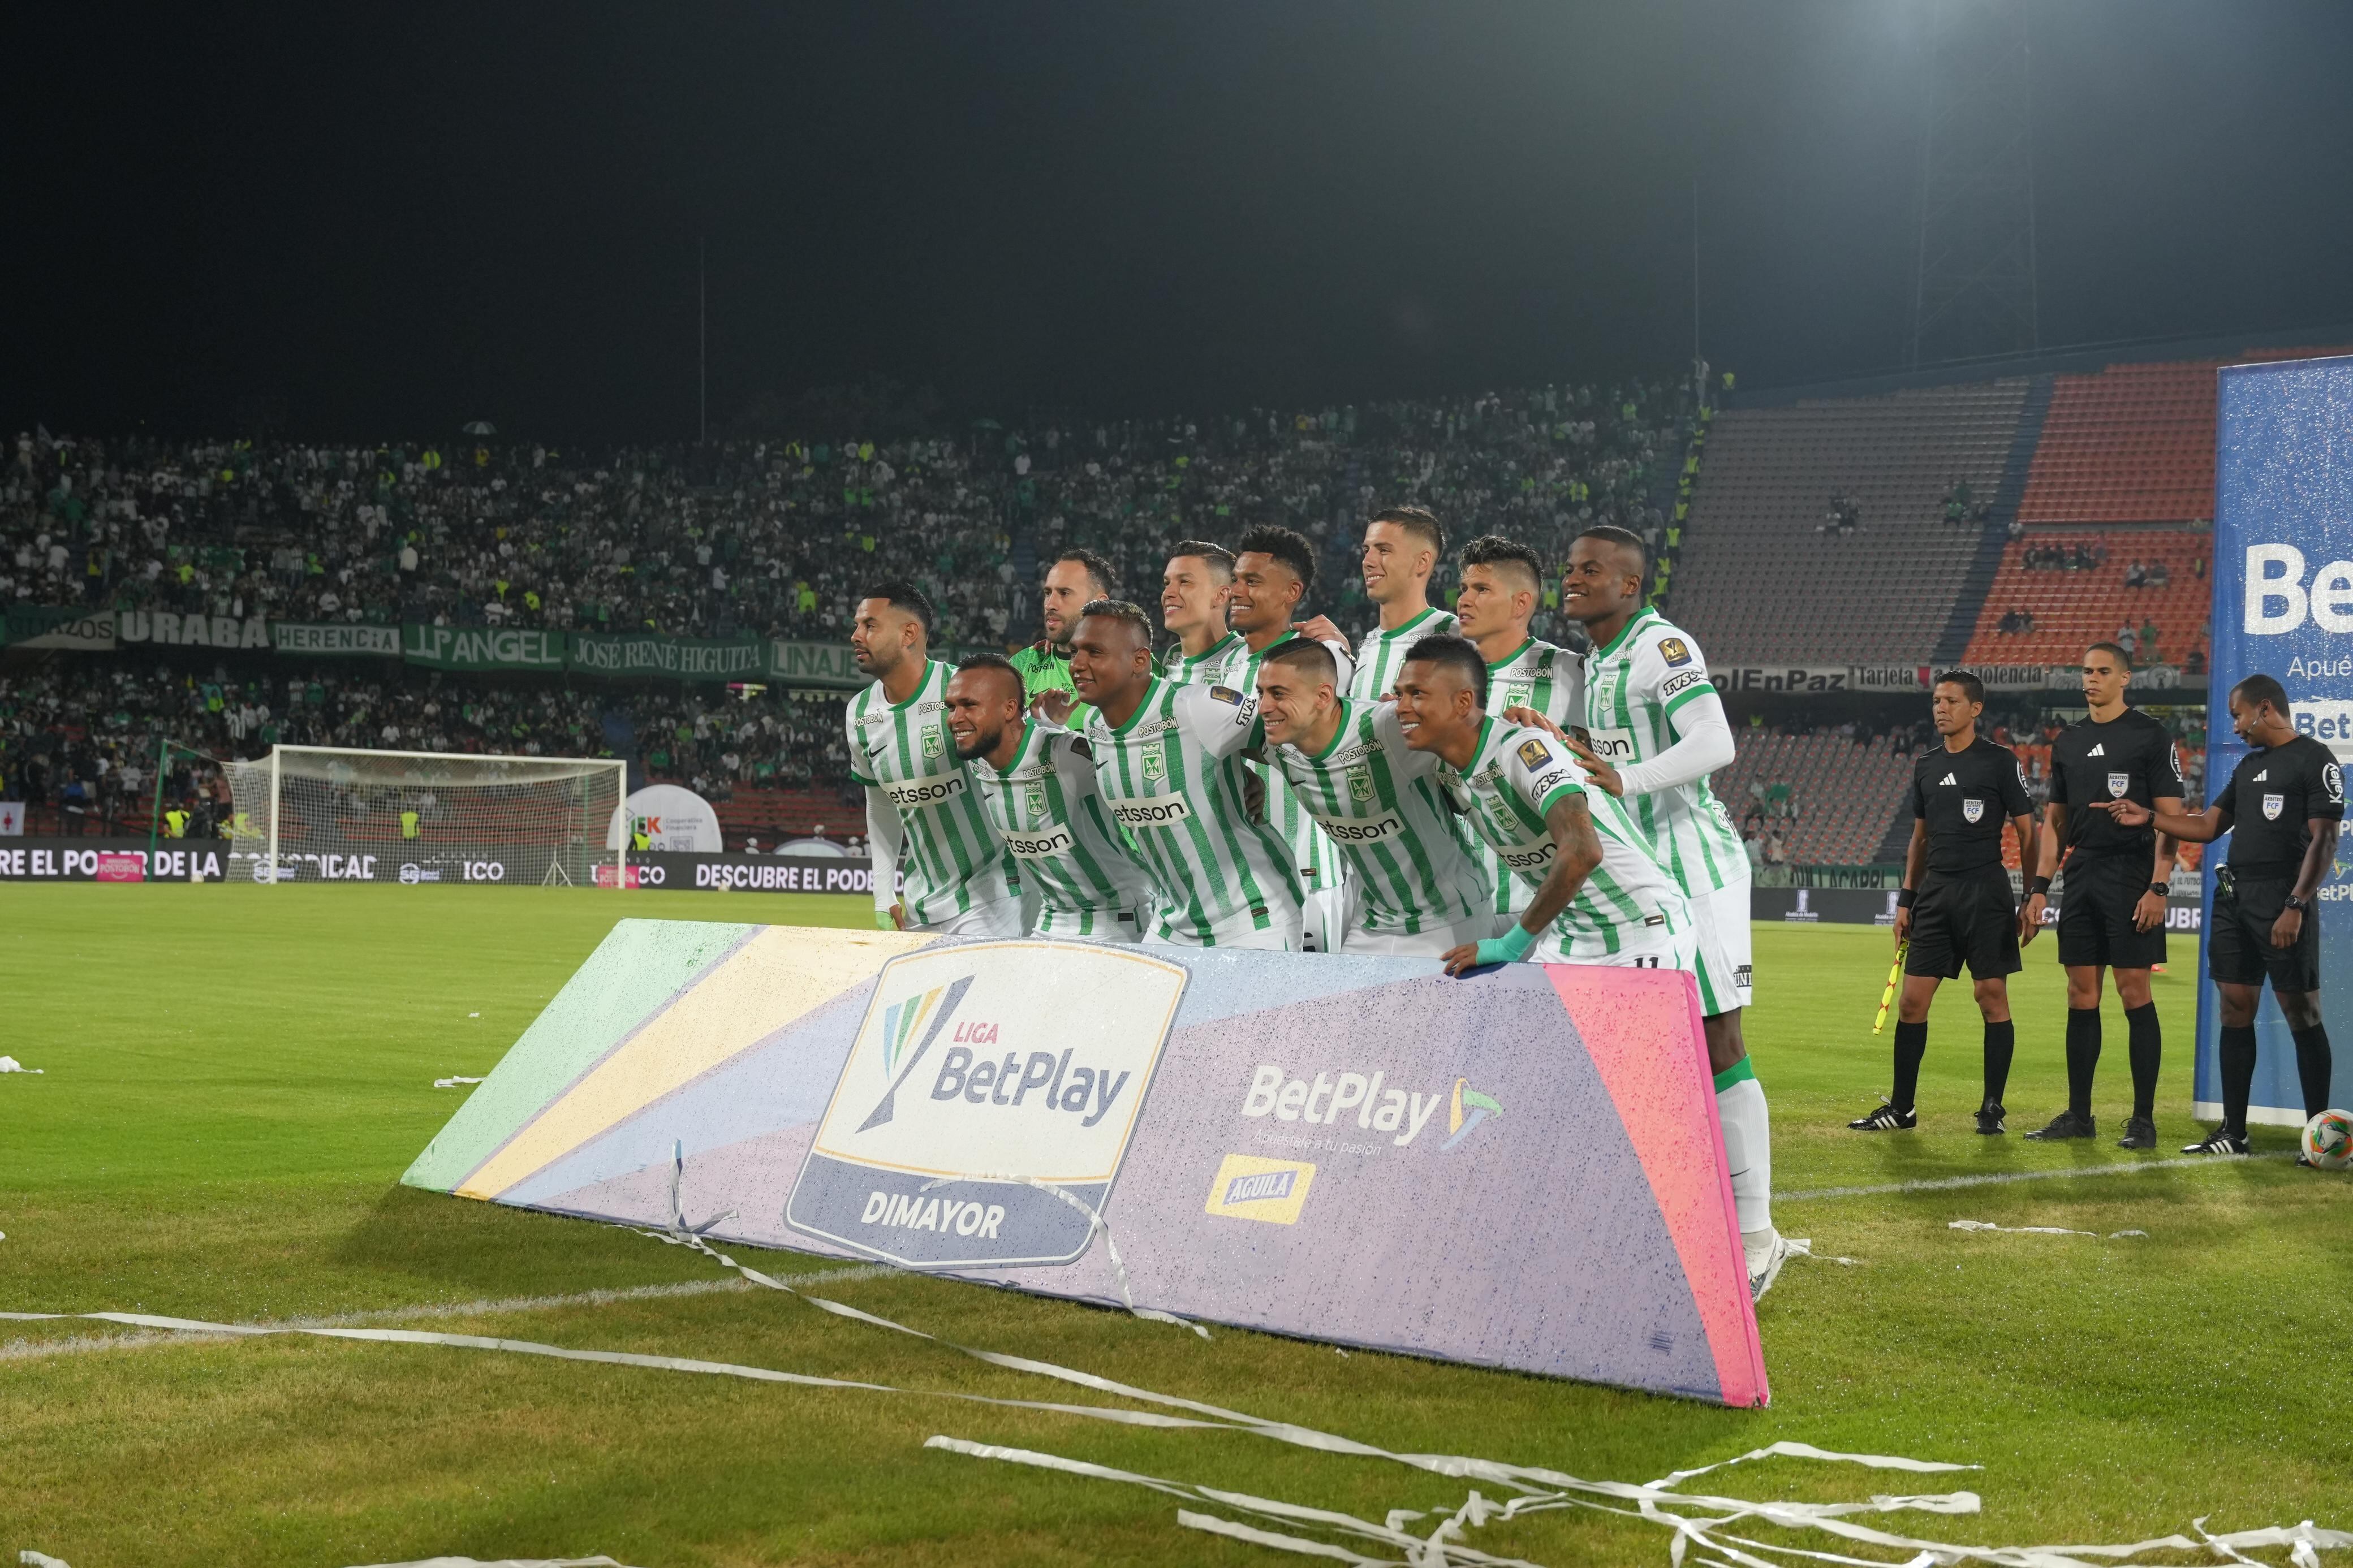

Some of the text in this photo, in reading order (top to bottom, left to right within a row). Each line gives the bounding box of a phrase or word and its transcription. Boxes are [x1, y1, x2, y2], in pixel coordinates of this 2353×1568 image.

[122, 611, 270, 649] URABA
[453, 629, 561, 663] ANGEL
[575, 636, 761, 673] JOSÉ RENÉ HIGUITA
[772, 643, 860, 680] LINAJE
[1510, 663, 1554, 680] POSTOBÓN
[1663, 671, 1692, 697] TVS
[1859, 666, 1913, 687] Tarjeta
[853, 709, 884, 730] POSTOBÓN
[919, 701, 949, 715] POSTOB
[1138, 715, 1179, 738] POSTOBÓN
[2295, 712, 2350, 739] Bet
[1337, 737, 1385, 764] POSTOBÓN
[1023, 759, 1057, 778] POSTOBÓN
[889, 778, 962, 804] etsson
[2329, 762, 2342, 804] Kalley
[1005, 832, 1070, 854] tsson
[31, 850, 58, 876] EL
[154, 851, 186, 876] DE
[191, 852, 221, 877] LA
[696, 863, 799, 889] DESCUBRE
[803, 868, 823, 891] EL
[826, 869, 874, 892] PODE
[2317, 883, 2353, 901] etPl
[953, 1022, 999, 1044] LIGA
[930, 1046, 1131, 1128] BetPlay
[1241, 1065, 1443, 1146] BetPlay
[1253, 1129, 1382, 1156] Apuéstale a tu pasión
[861, 1190, 1005, 1239] DIMAYOR
